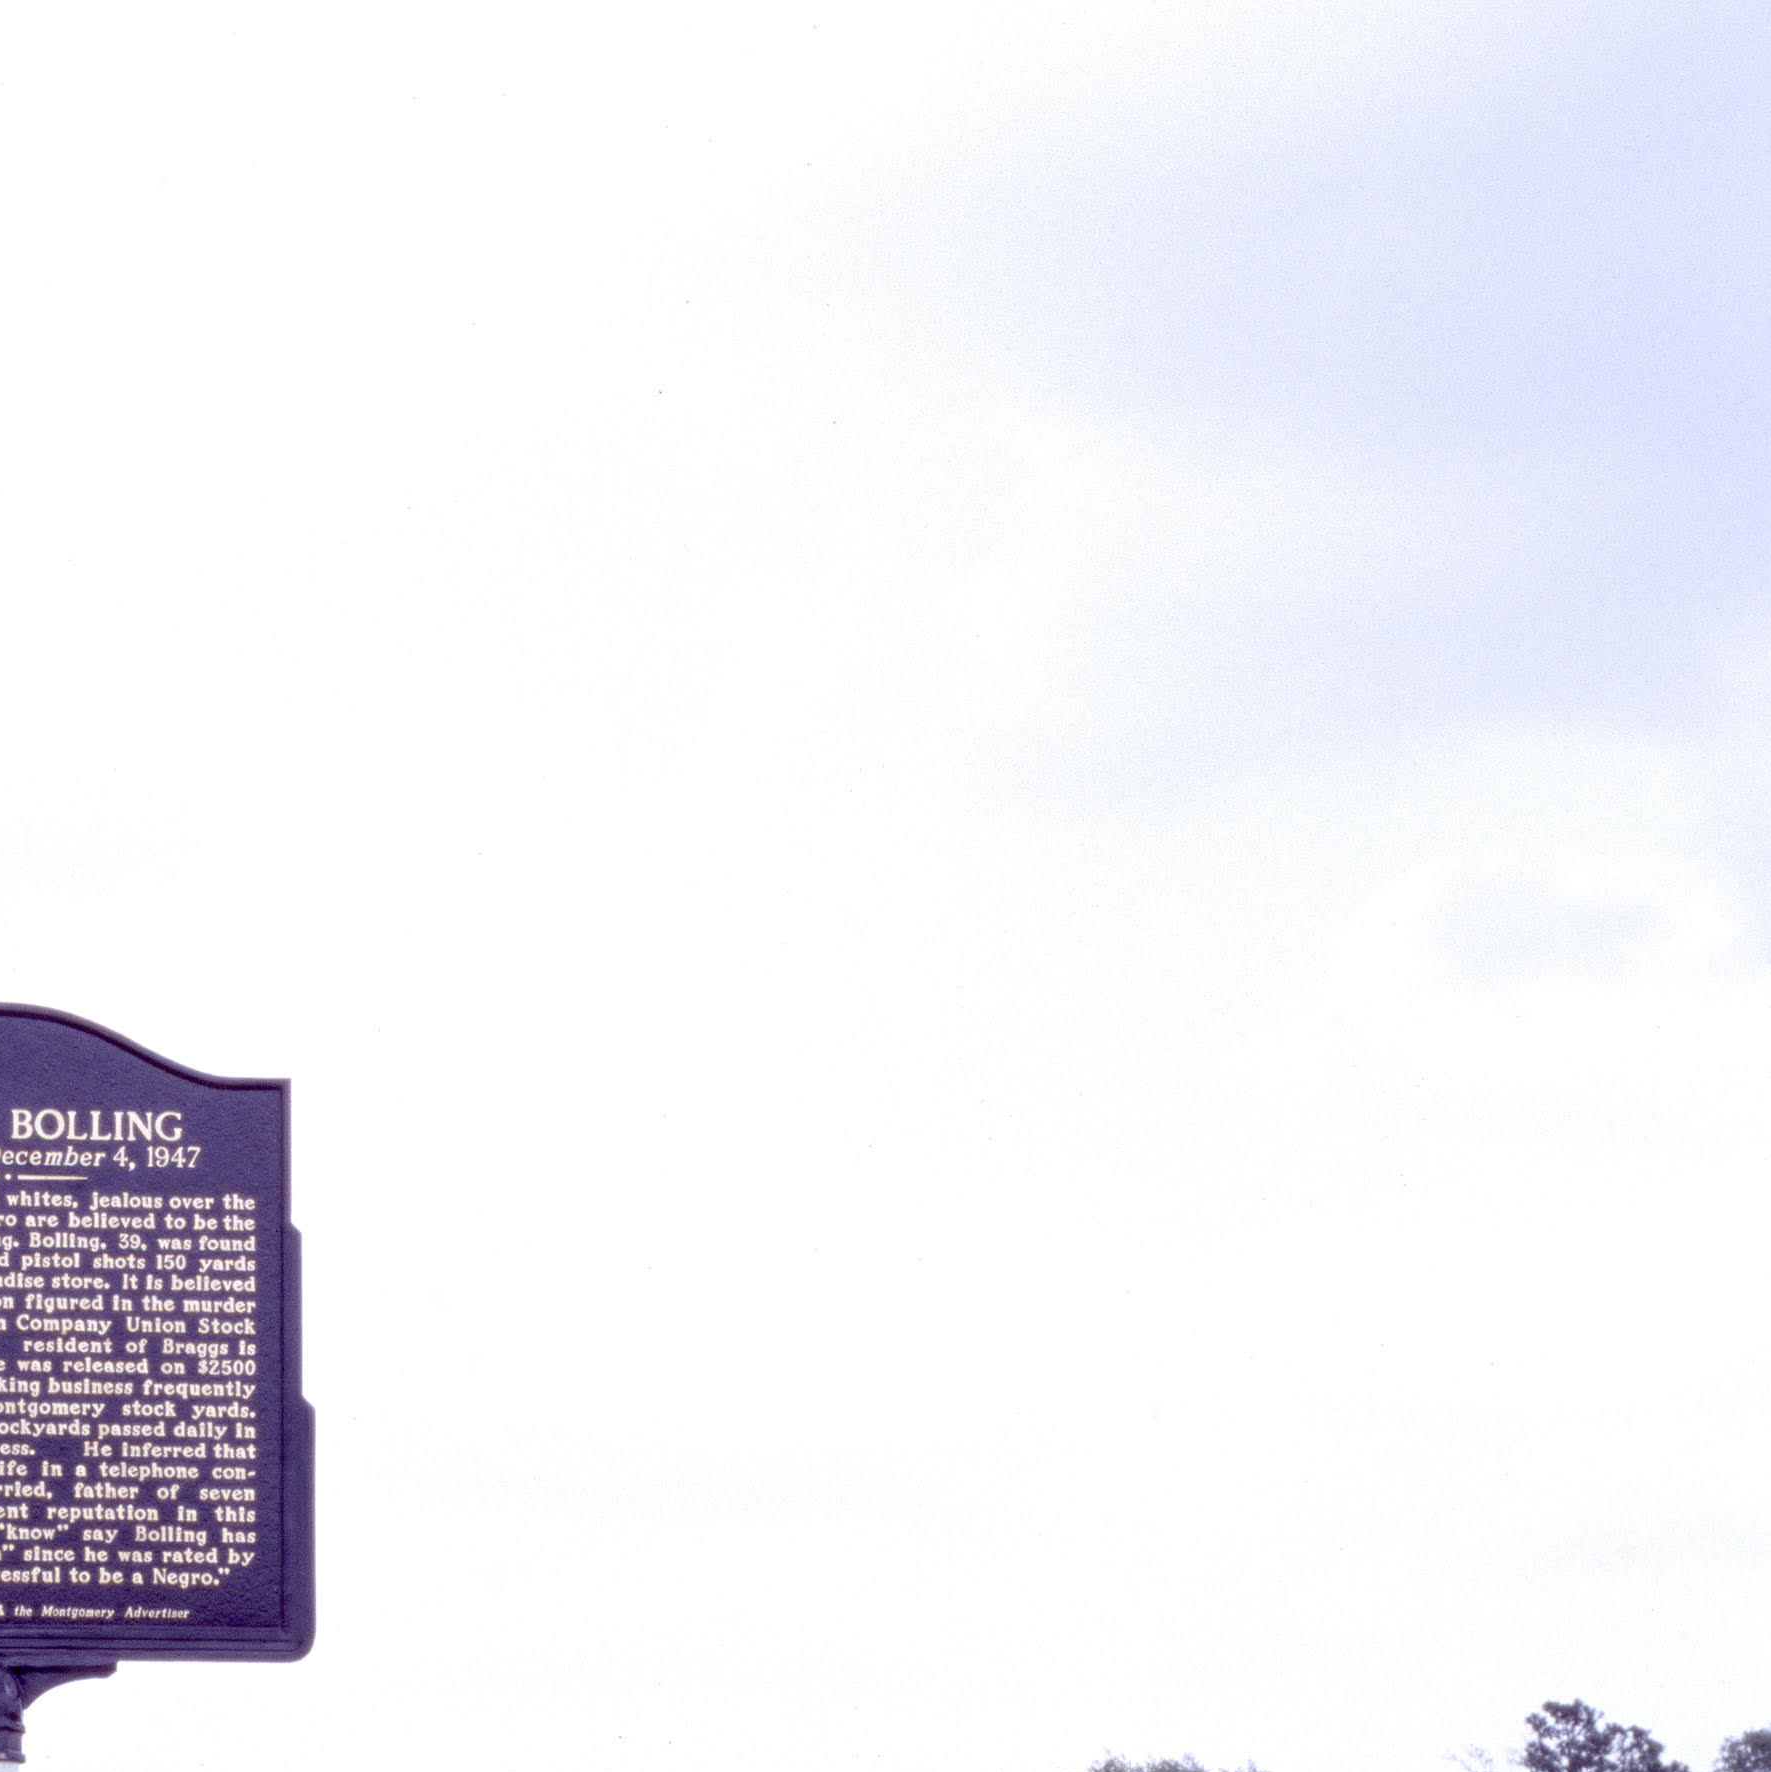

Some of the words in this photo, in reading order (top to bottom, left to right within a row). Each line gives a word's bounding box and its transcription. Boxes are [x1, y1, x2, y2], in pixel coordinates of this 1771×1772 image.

[10, 1108, 183, 1142] BOLLING
[112, 1145, 136, 1172] 4,
[146, 1145, 201, 1169] 1947
[90, 1191, 163, 1212] jealous
[169, 1196, 215, 1210] over
[223, 1193, 256, 1211] the
[25, 1214, 59, 1228] are
[68, 1211, 156, 1230] believed
[164, 1213, 187, 1230] to
[193, 1213, 218, 1231] be
[223, 1214, 256, 1232] the
[158, 1238, 192, 1251] was
[199, 1234, 256, 1252] found
[22, 1252, 81, 1271] pistol
[93, 1253, 146, 1270] shots
[156, 1254, 187, 1271] 150
[199, 1255, 256, 1274] yards
[52, 1272, 111, 1290] store.
[123, 1273, 139, 1290] It
[171, 1273, 256, 1293] believed
[25, 1292, 104, 1314] figured
[113, 1293, 133, 1312] in
[142, 1294, 176, 1312] the
[183, 1296, 257, 1314] murder
[16, 1313, 113, 1336] Company
[127, 1315, 187, 1334] Union
[198, 1317, 256, 1335] Stock
[24, 1336, 113, 1354] resident
[126, 1338, 148, 1354] of
[163, 1338, 230, 1357] Braggs
[239, 1339, 257, 1356] is
[17, 1359, 52, 1373] was
[63, 1356, 149, 1375] released
[161, 1362, 186, 1375] on
[197, 1357, 257, 1376] $2500
[48, 1376, 134, 1395] business
[143, 1378, 256, 1400] frequently
[123, 1399, 177, 1418] stock
[192, 1401, 256, 1420] yards.
[98, 1420, 166, 1440] passed
[174, 1420, 228, 1441] daily
[236, 1421, 256, 1439] in
[84, 1440, 112, 1457] He
[122, 1441, 207, 1459] inferred
[213, 1442, 257, 1460] that
[99, 1461, 200, 1482] telephone
[74, 1481, 139, 1500] father
[157, 1483, 180, 1500] of
[200, 1487, 256, 1502] seven
[47, 1503, 159, 1524] reputation
[178, 1505, 198, 1522] in
[215, 1505, 256, 1523] this
[83, 1528, 119, 1544] say
[136, 1525, 207, 1547] Bolling
[222, 1527, 256, 1544] has
[24, 1545, 75, 1562] since
[85, 1546, 109, 1563] he
[118, 1550, 153, 1563] was
[163, 1547, 218, 1564] rated
[228, 1547, 255, 1567] by
[69, 1567, 91, 1584] to
[99, 1566, 124, 1584] be
[42, 1605, 115, 1619] Montgomery
[125, 1606, 190, 1619] Advertiser
